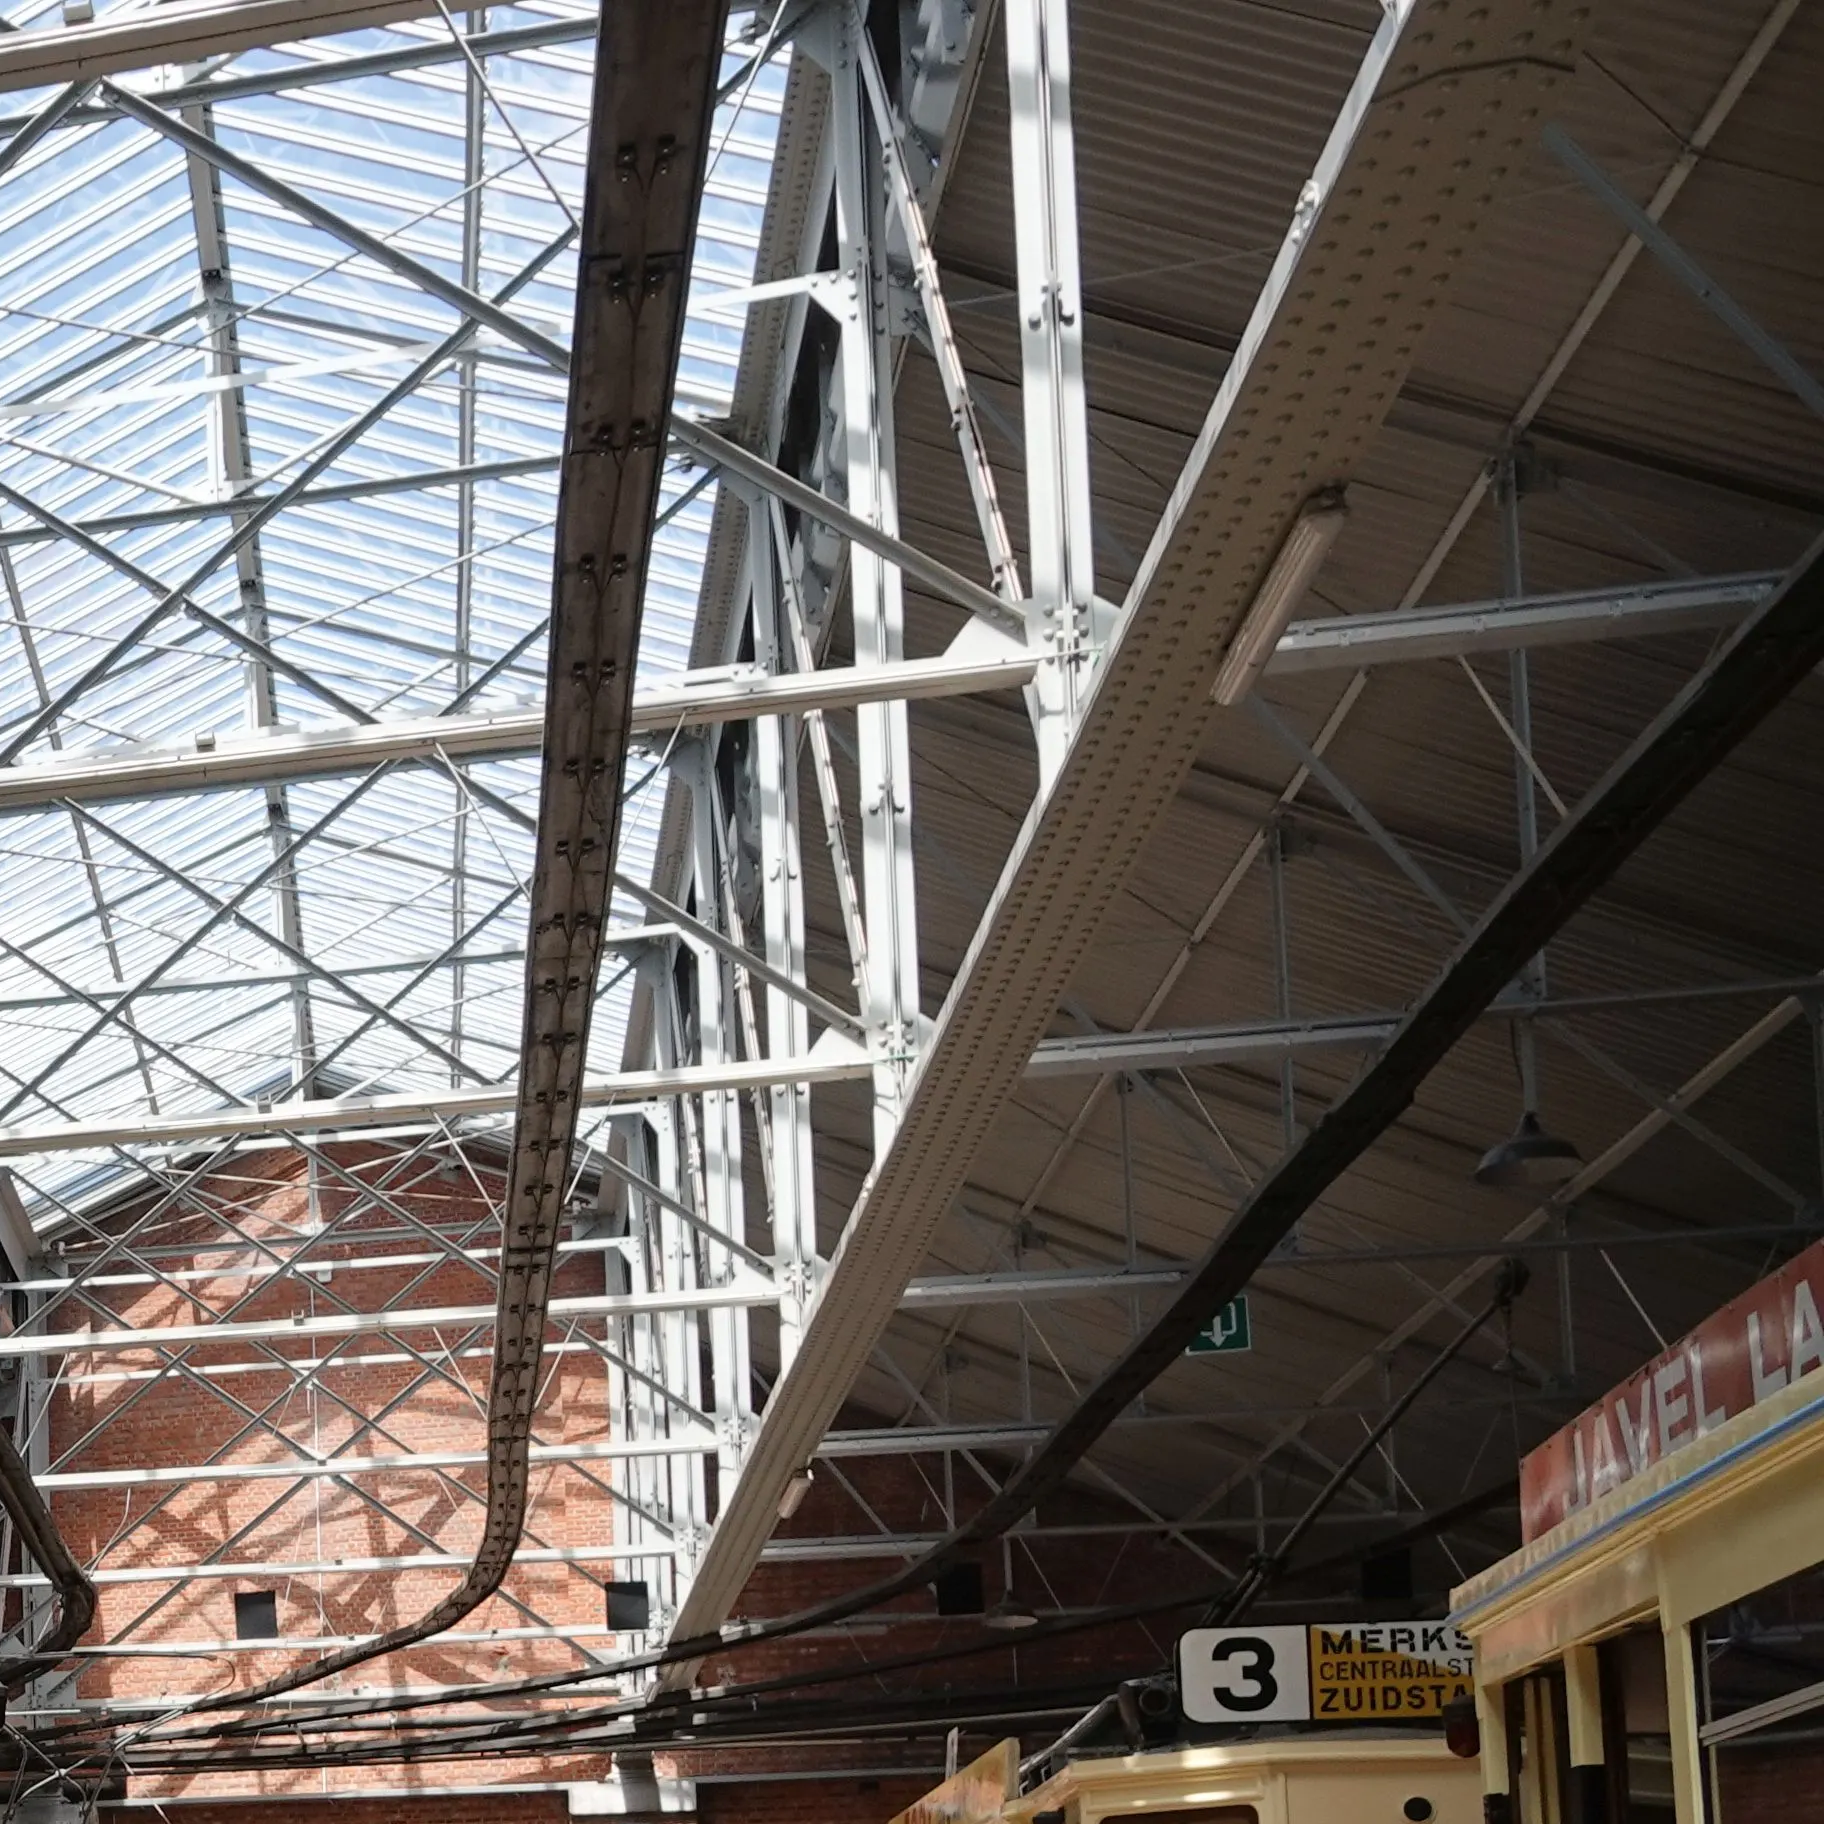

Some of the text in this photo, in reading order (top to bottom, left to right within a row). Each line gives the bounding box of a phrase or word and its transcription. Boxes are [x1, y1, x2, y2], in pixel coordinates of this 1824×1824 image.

[1563, 1279, 1824, 1517] JAVEL LA
[1212, 1637, 1278, 1712] 3
[1320, 1657, 1474, 1680] CENTRAALST
